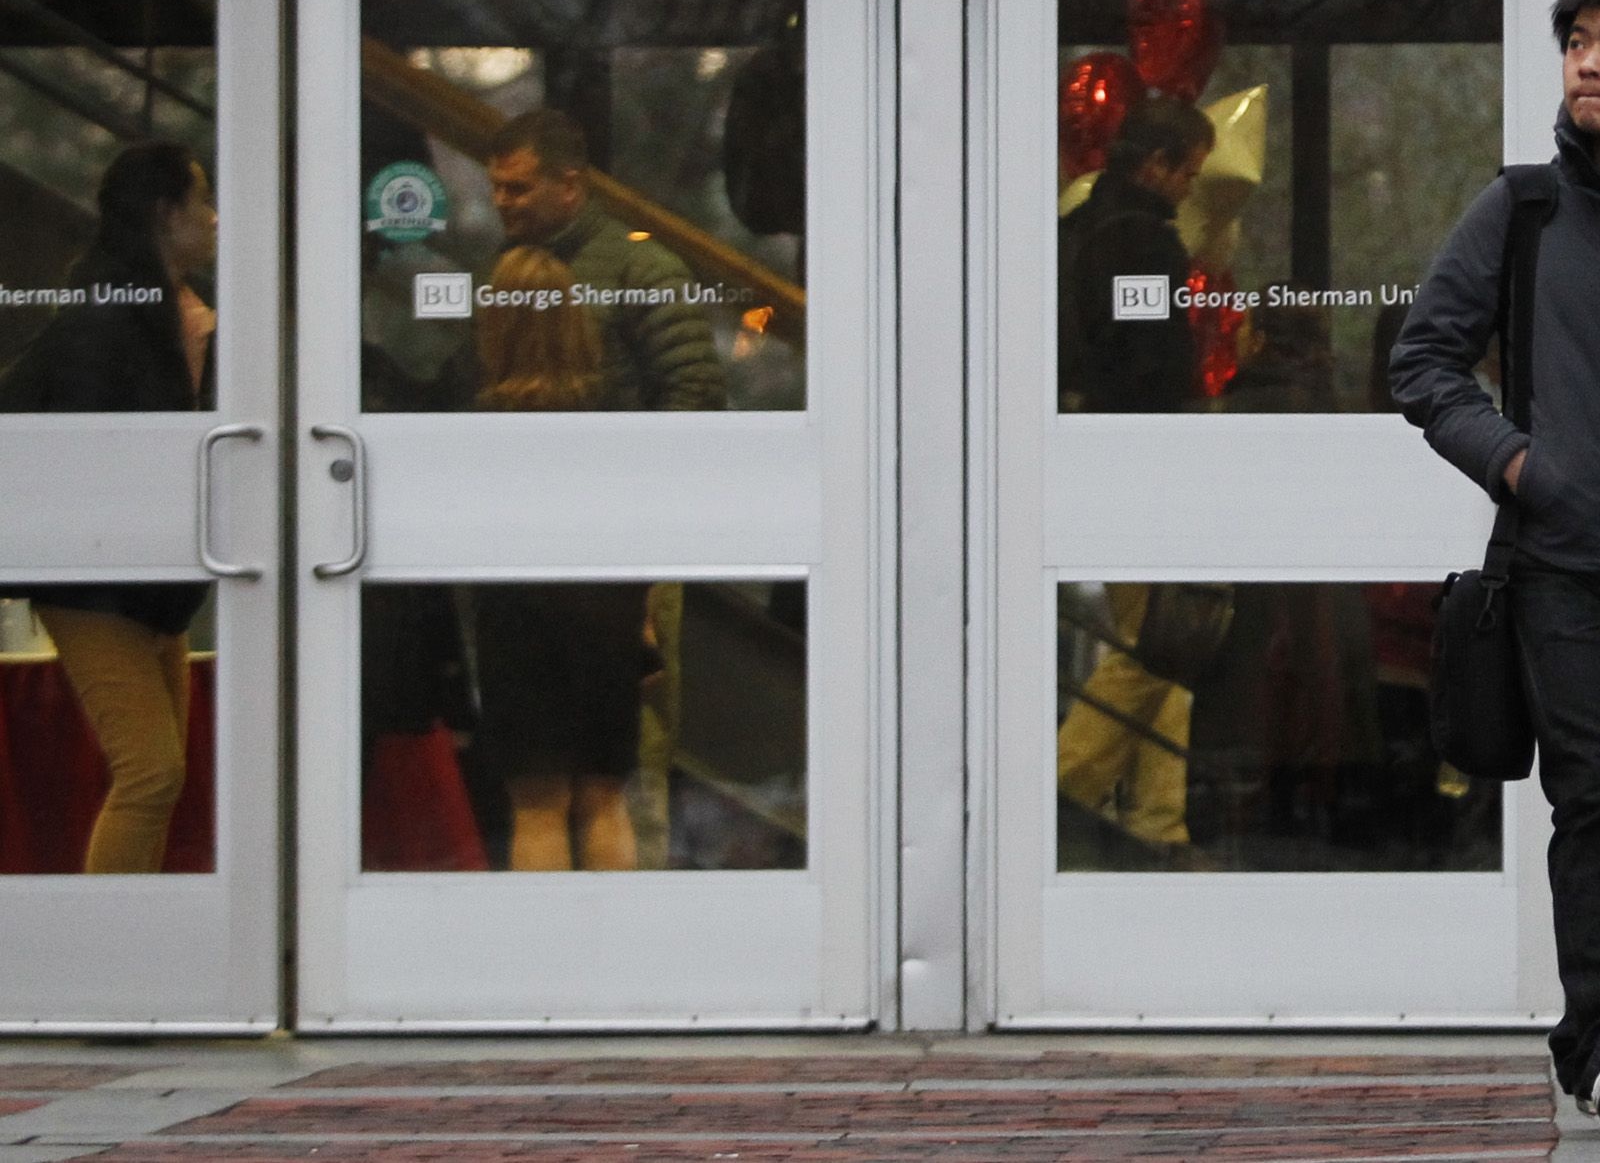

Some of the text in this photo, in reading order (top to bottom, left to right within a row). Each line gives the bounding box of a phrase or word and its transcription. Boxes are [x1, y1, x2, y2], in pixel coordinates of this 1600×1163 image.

[0, 282, 163, 305] herman Union
[423, 284, 465, 306] BU
[476, 284, 563, 310] George
[570, 283, 675, 305] Sherman
[1121, 287, 1162, 308] BU
[1173, 286, 1260, 310] George
[1266, 285, 1372, 307] Sherman
